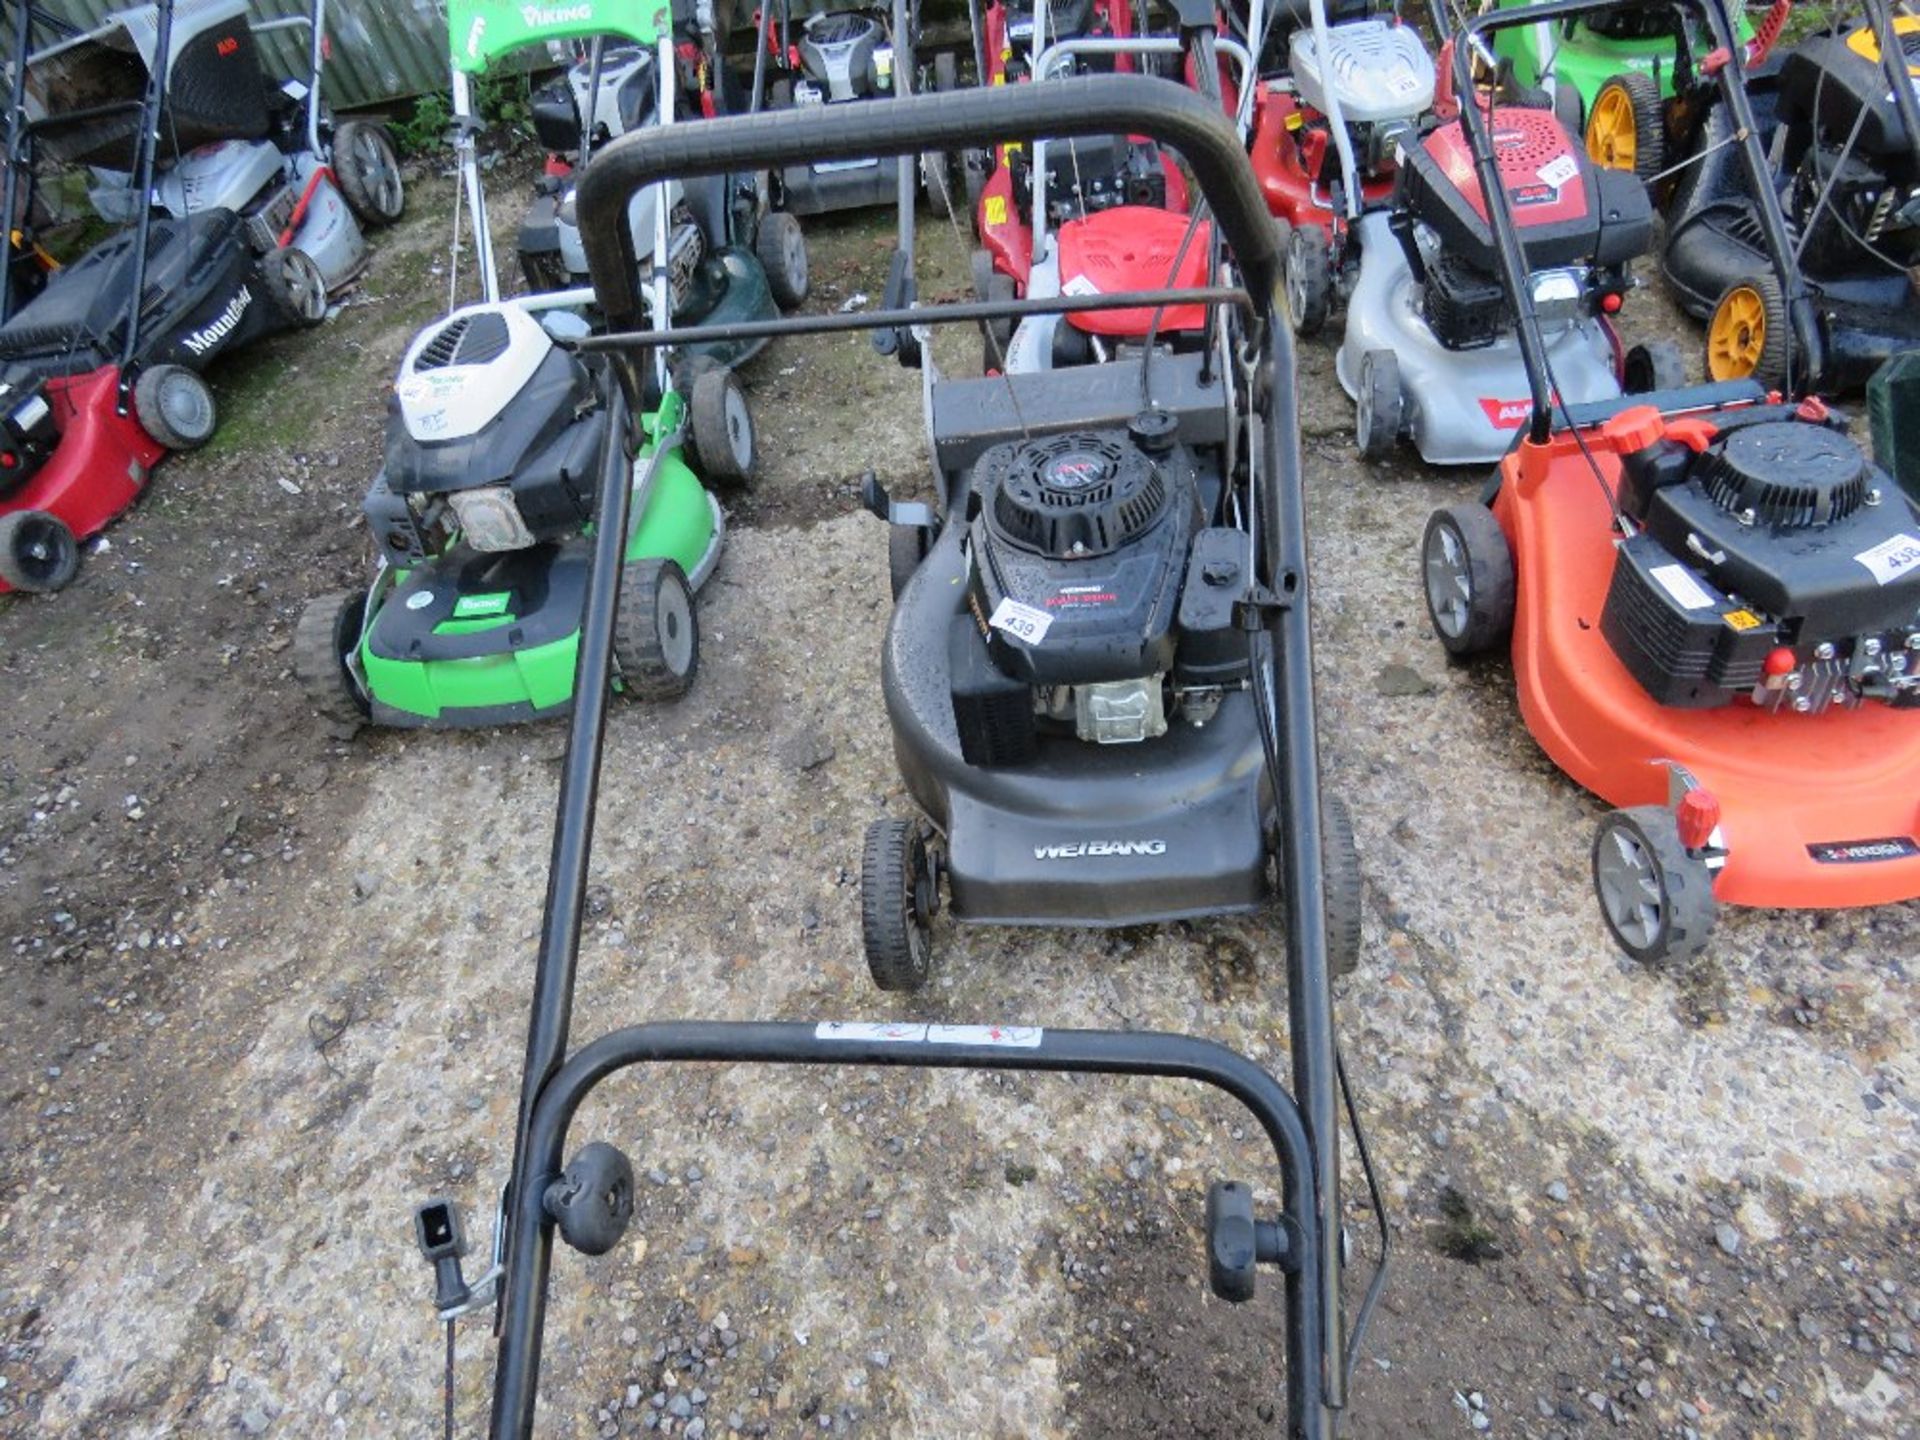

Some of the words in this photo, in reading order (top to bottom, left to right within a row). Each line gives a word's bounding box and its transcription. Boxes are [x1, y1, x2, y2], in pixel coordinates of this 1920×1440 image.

[520, 4, 592, 27] VIKING
[182, 283, 252, 356] Mountfield
[1888, 546, 1920, 568] 438
[1004, 617, 1036, 637] 439
[1034, 839, 1166, 860] WEIBANG
